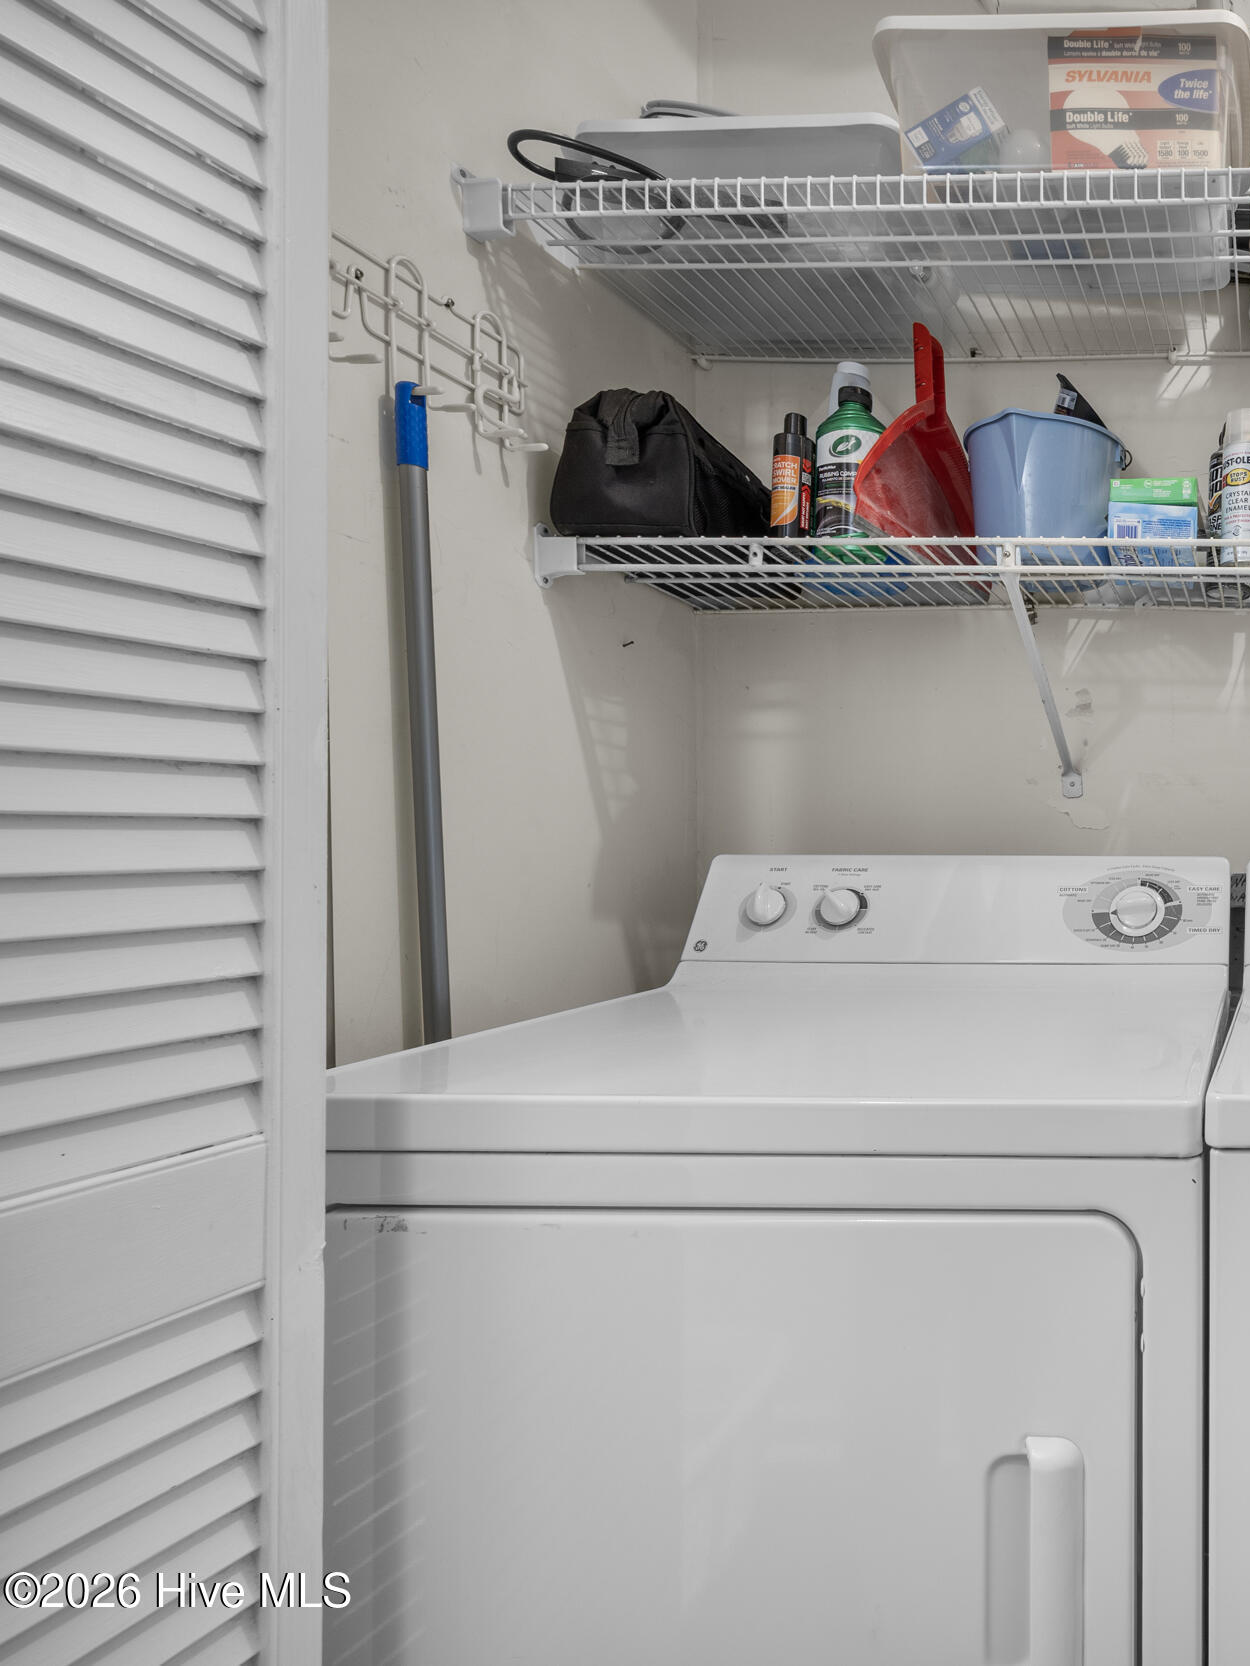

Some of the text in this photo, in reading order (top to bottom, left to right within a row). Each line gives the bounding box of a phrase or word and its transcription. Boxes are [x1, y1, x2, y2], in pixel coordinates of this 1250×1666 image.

[1064, 40, 1092, 49] Double
[1178, 43, 1191, 52] 100
[1065, 70, 1152, 84] SYLVANIA
[1179, 78, 1209, 89] Twice
[1174, 89, 1190, 99] the
[1065, 111, 1105, 123] Double
[1175, 113, 1189, 122] 100
